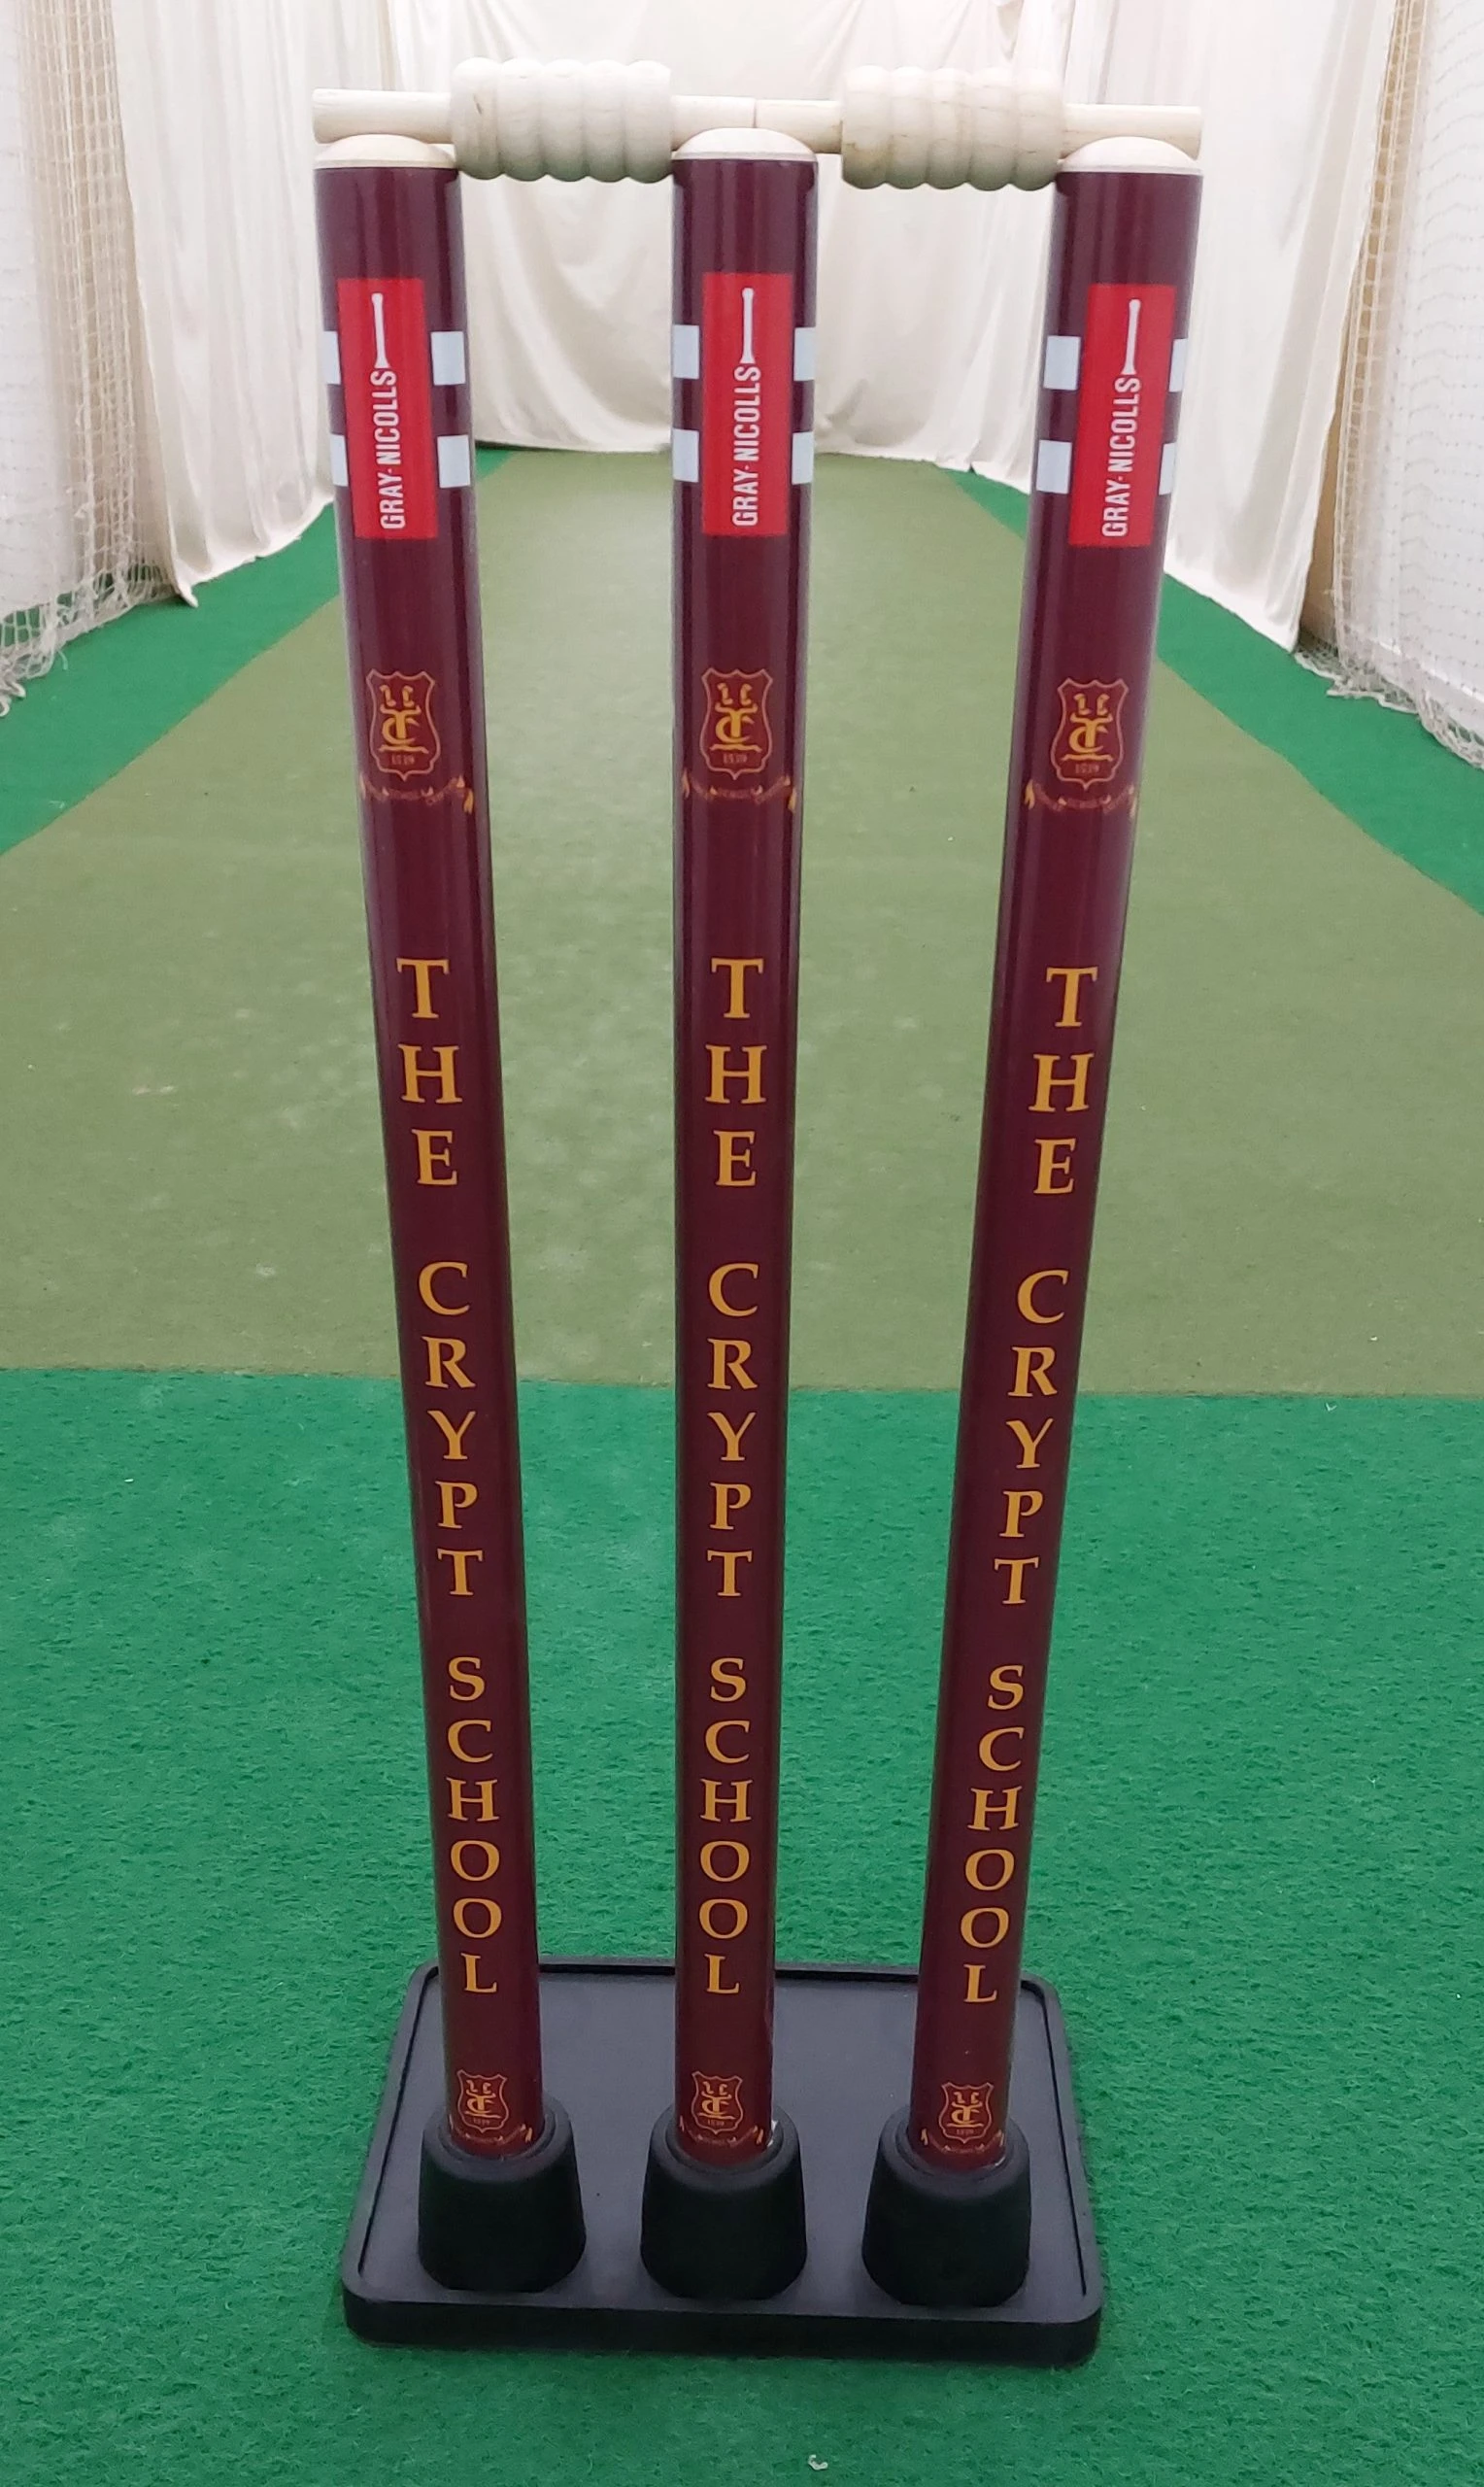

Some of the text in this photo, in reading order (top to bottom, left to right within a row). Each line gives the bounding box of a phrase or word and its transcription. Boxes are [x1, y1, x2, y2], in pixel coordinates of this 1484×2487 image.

[397, 959, 502, 1993] THE CRYPT SCHOOL
[698, 959, 763, 1993] THE CRYPT SCHOOL
[961, 968, 1097, 2002] THE CRYPT SCHOOL
